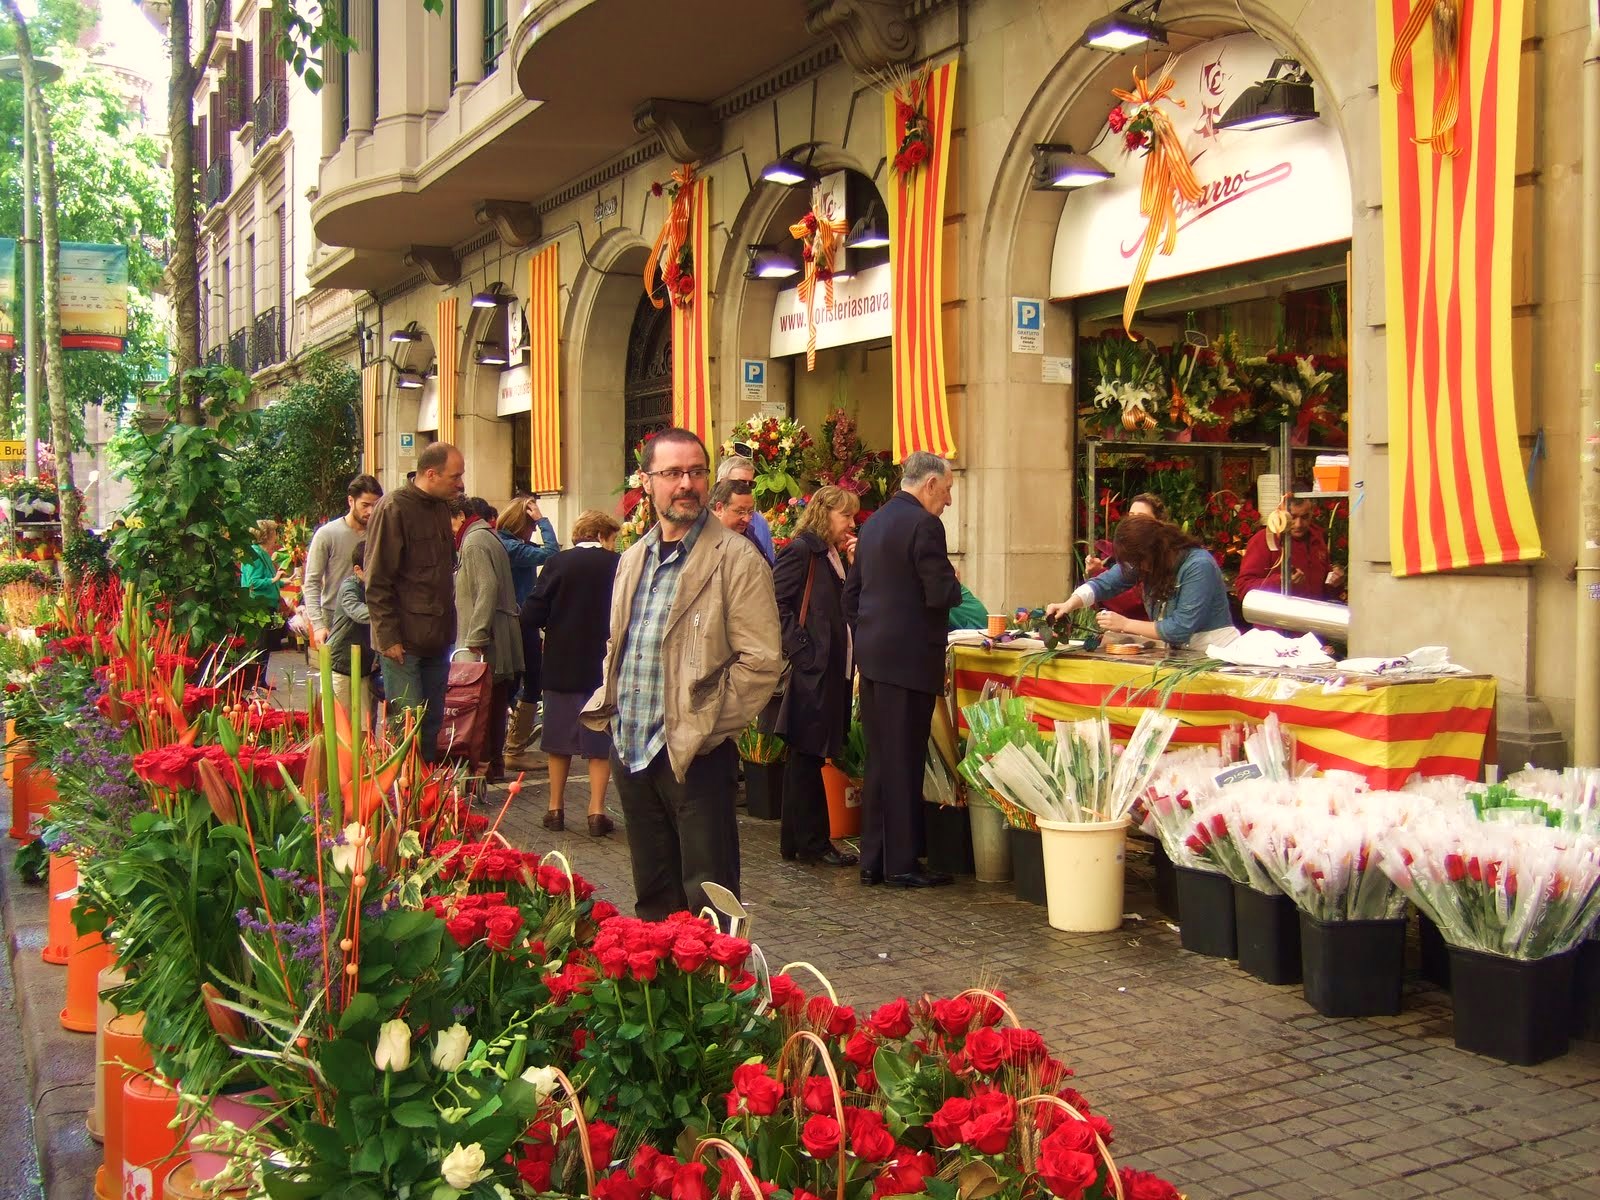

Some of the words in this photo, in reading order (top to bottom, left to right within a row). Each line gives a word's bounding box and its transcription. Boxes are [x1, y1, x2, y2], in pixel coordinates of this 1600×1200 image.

[780, 292, 889, 332] www.oristeriasnava
[1022, 305, 1036, 326] P
[749, 365, 760, 380] P
[402, 435, 411, 445] P
